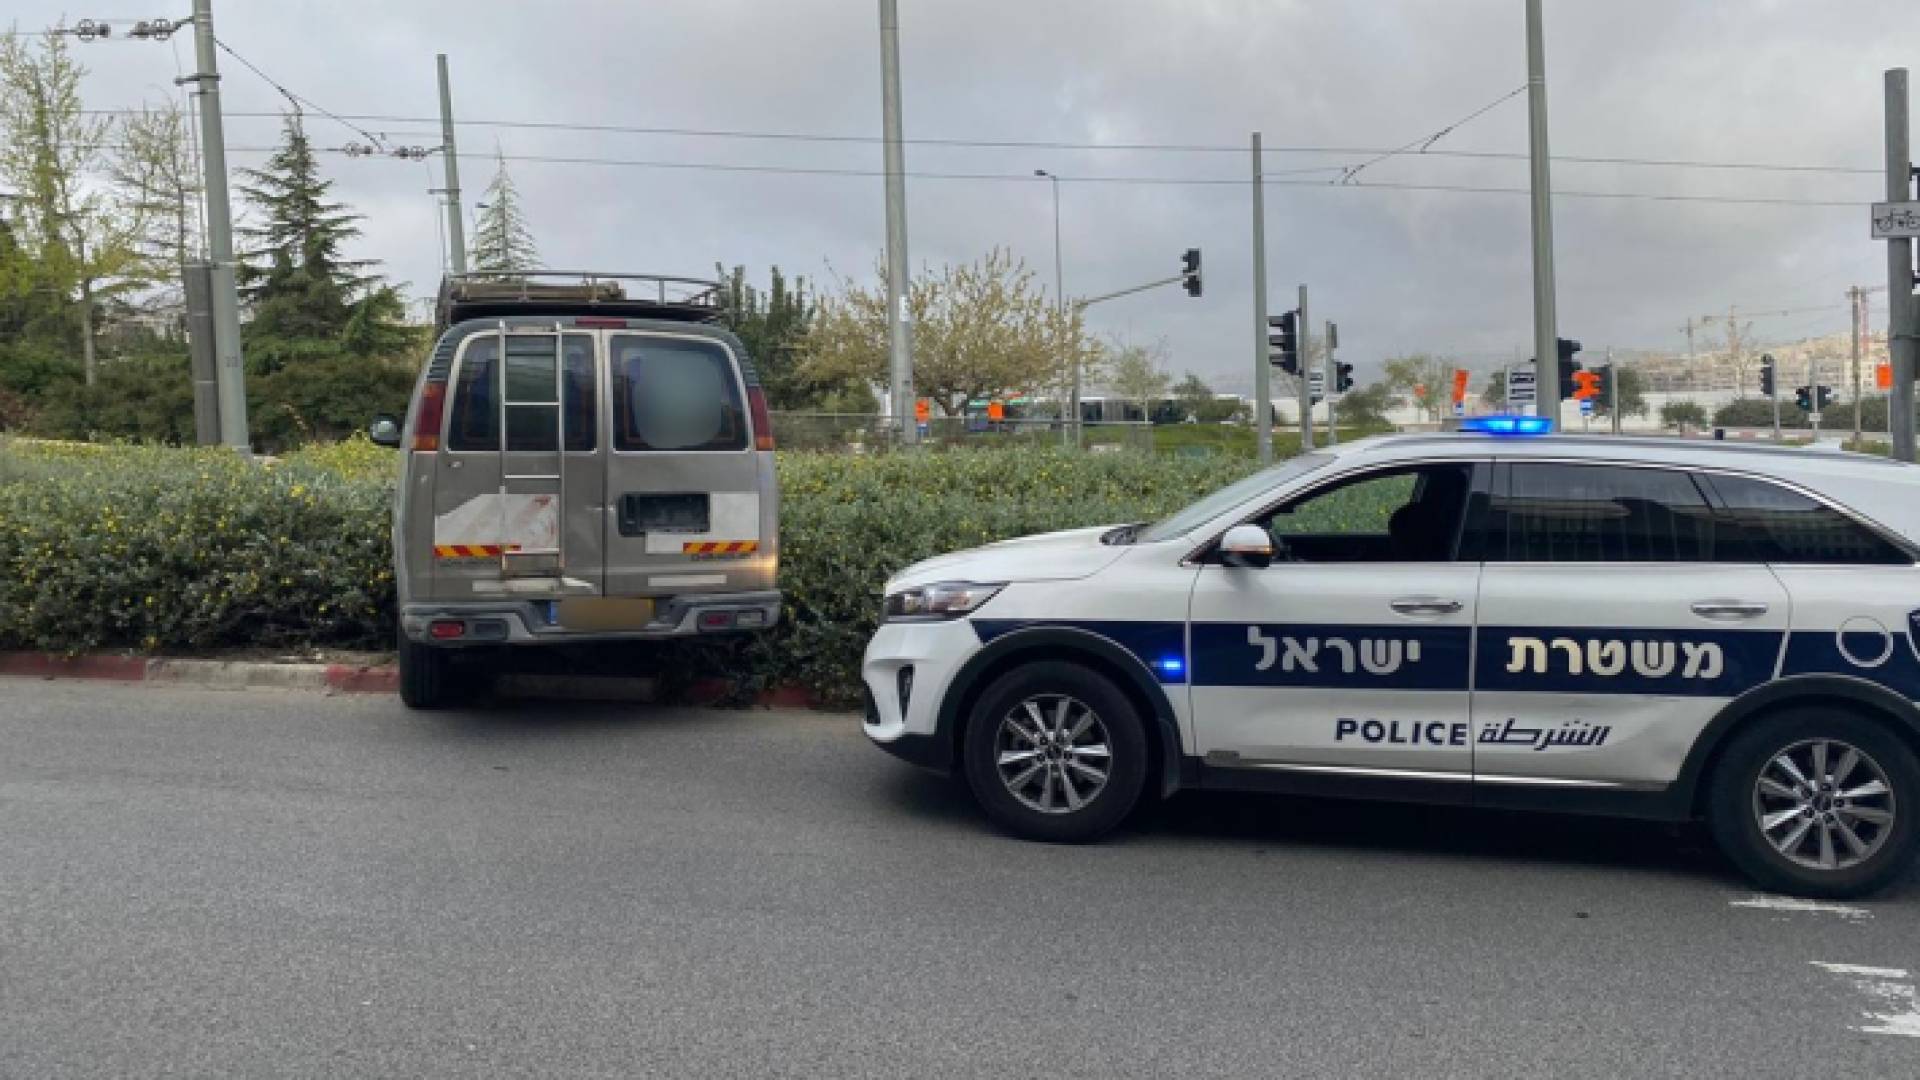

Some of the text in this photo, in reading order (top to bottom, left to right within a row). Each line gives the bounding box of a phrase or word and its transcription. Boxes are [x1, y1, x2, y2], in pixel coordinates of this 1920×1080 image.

[1247, 625, 1724, 678] משטרת ישראל
[1335, 719, 1467, 745] POLICE
[1477, 717, 1611, 750] الشرطة
